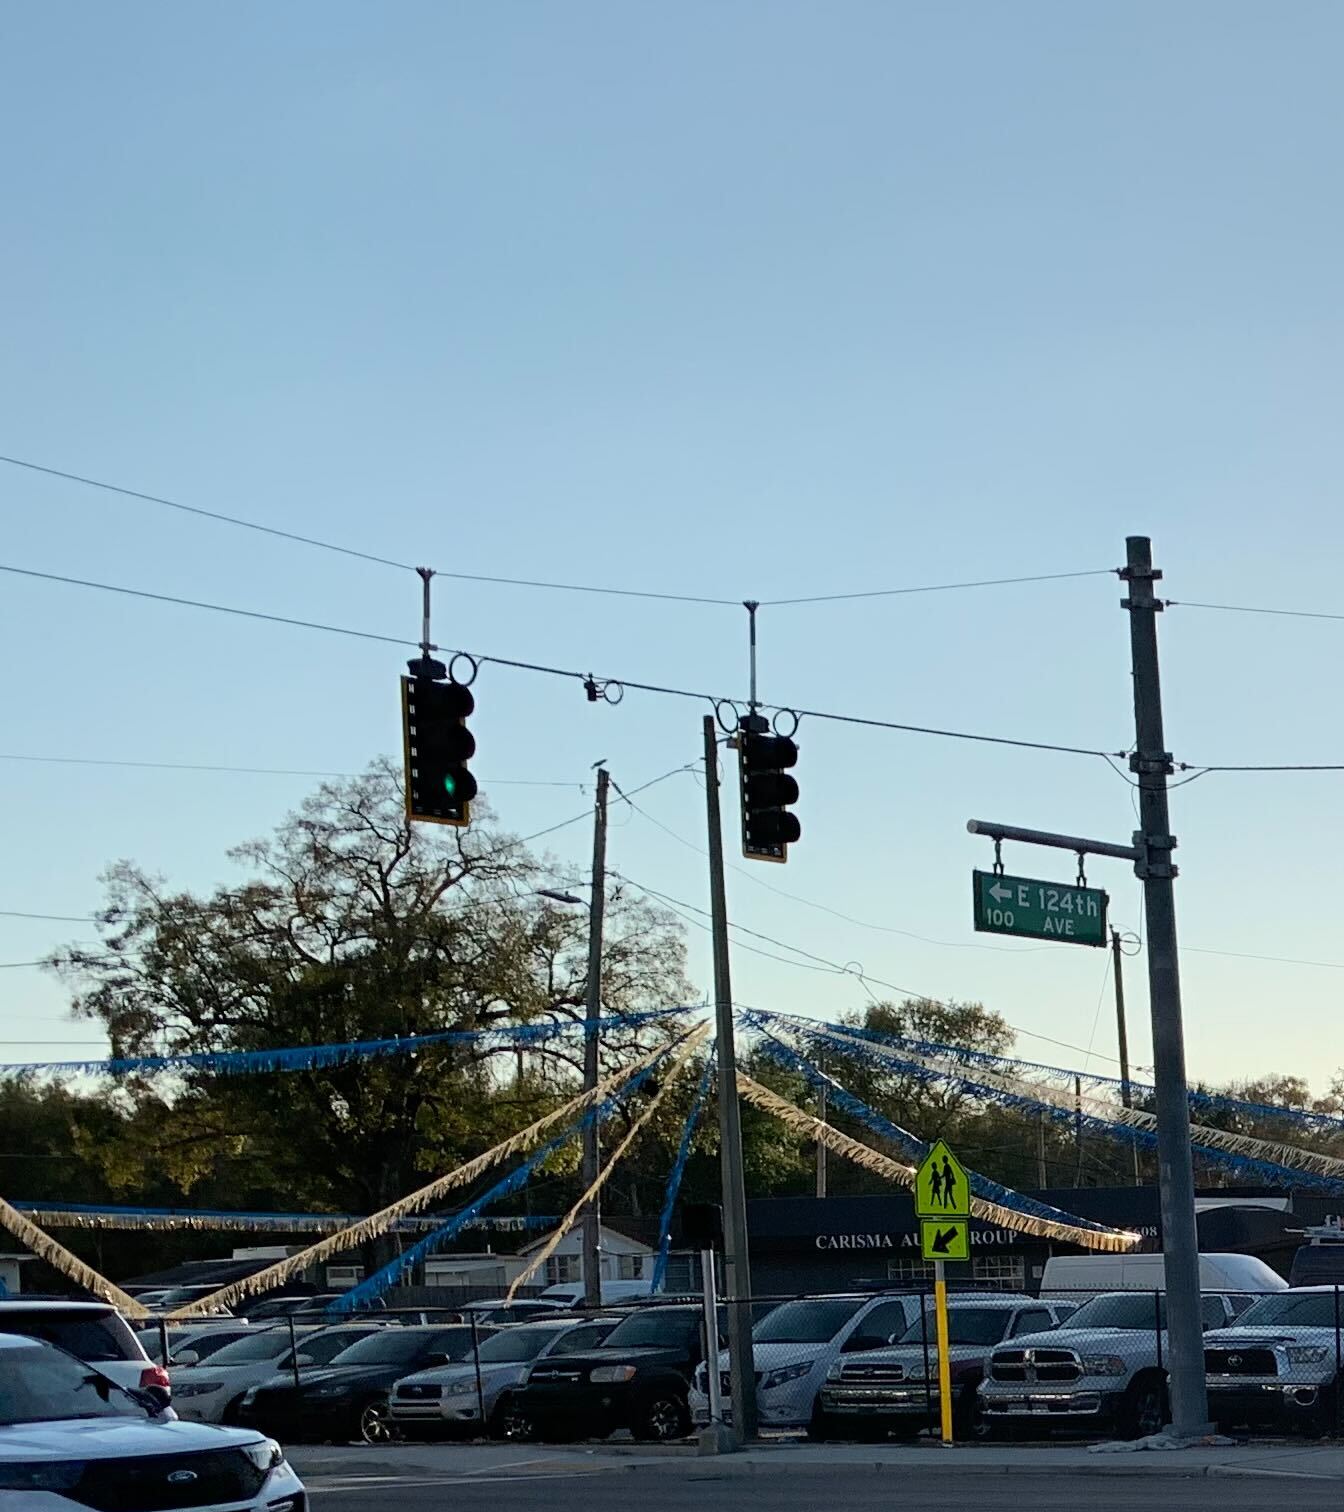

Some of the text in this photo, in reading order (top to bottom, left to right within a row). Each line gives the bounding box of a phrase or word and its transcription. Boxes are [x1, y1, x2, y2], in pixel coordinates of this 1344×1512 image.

[1017, 885, 1098, 917] E 124th
[986, 908, 1075, 935] 100 AVE
[815, 1233, 893, 1249] CARISMA
[969, 1230, 1018, 1245] ROUP
